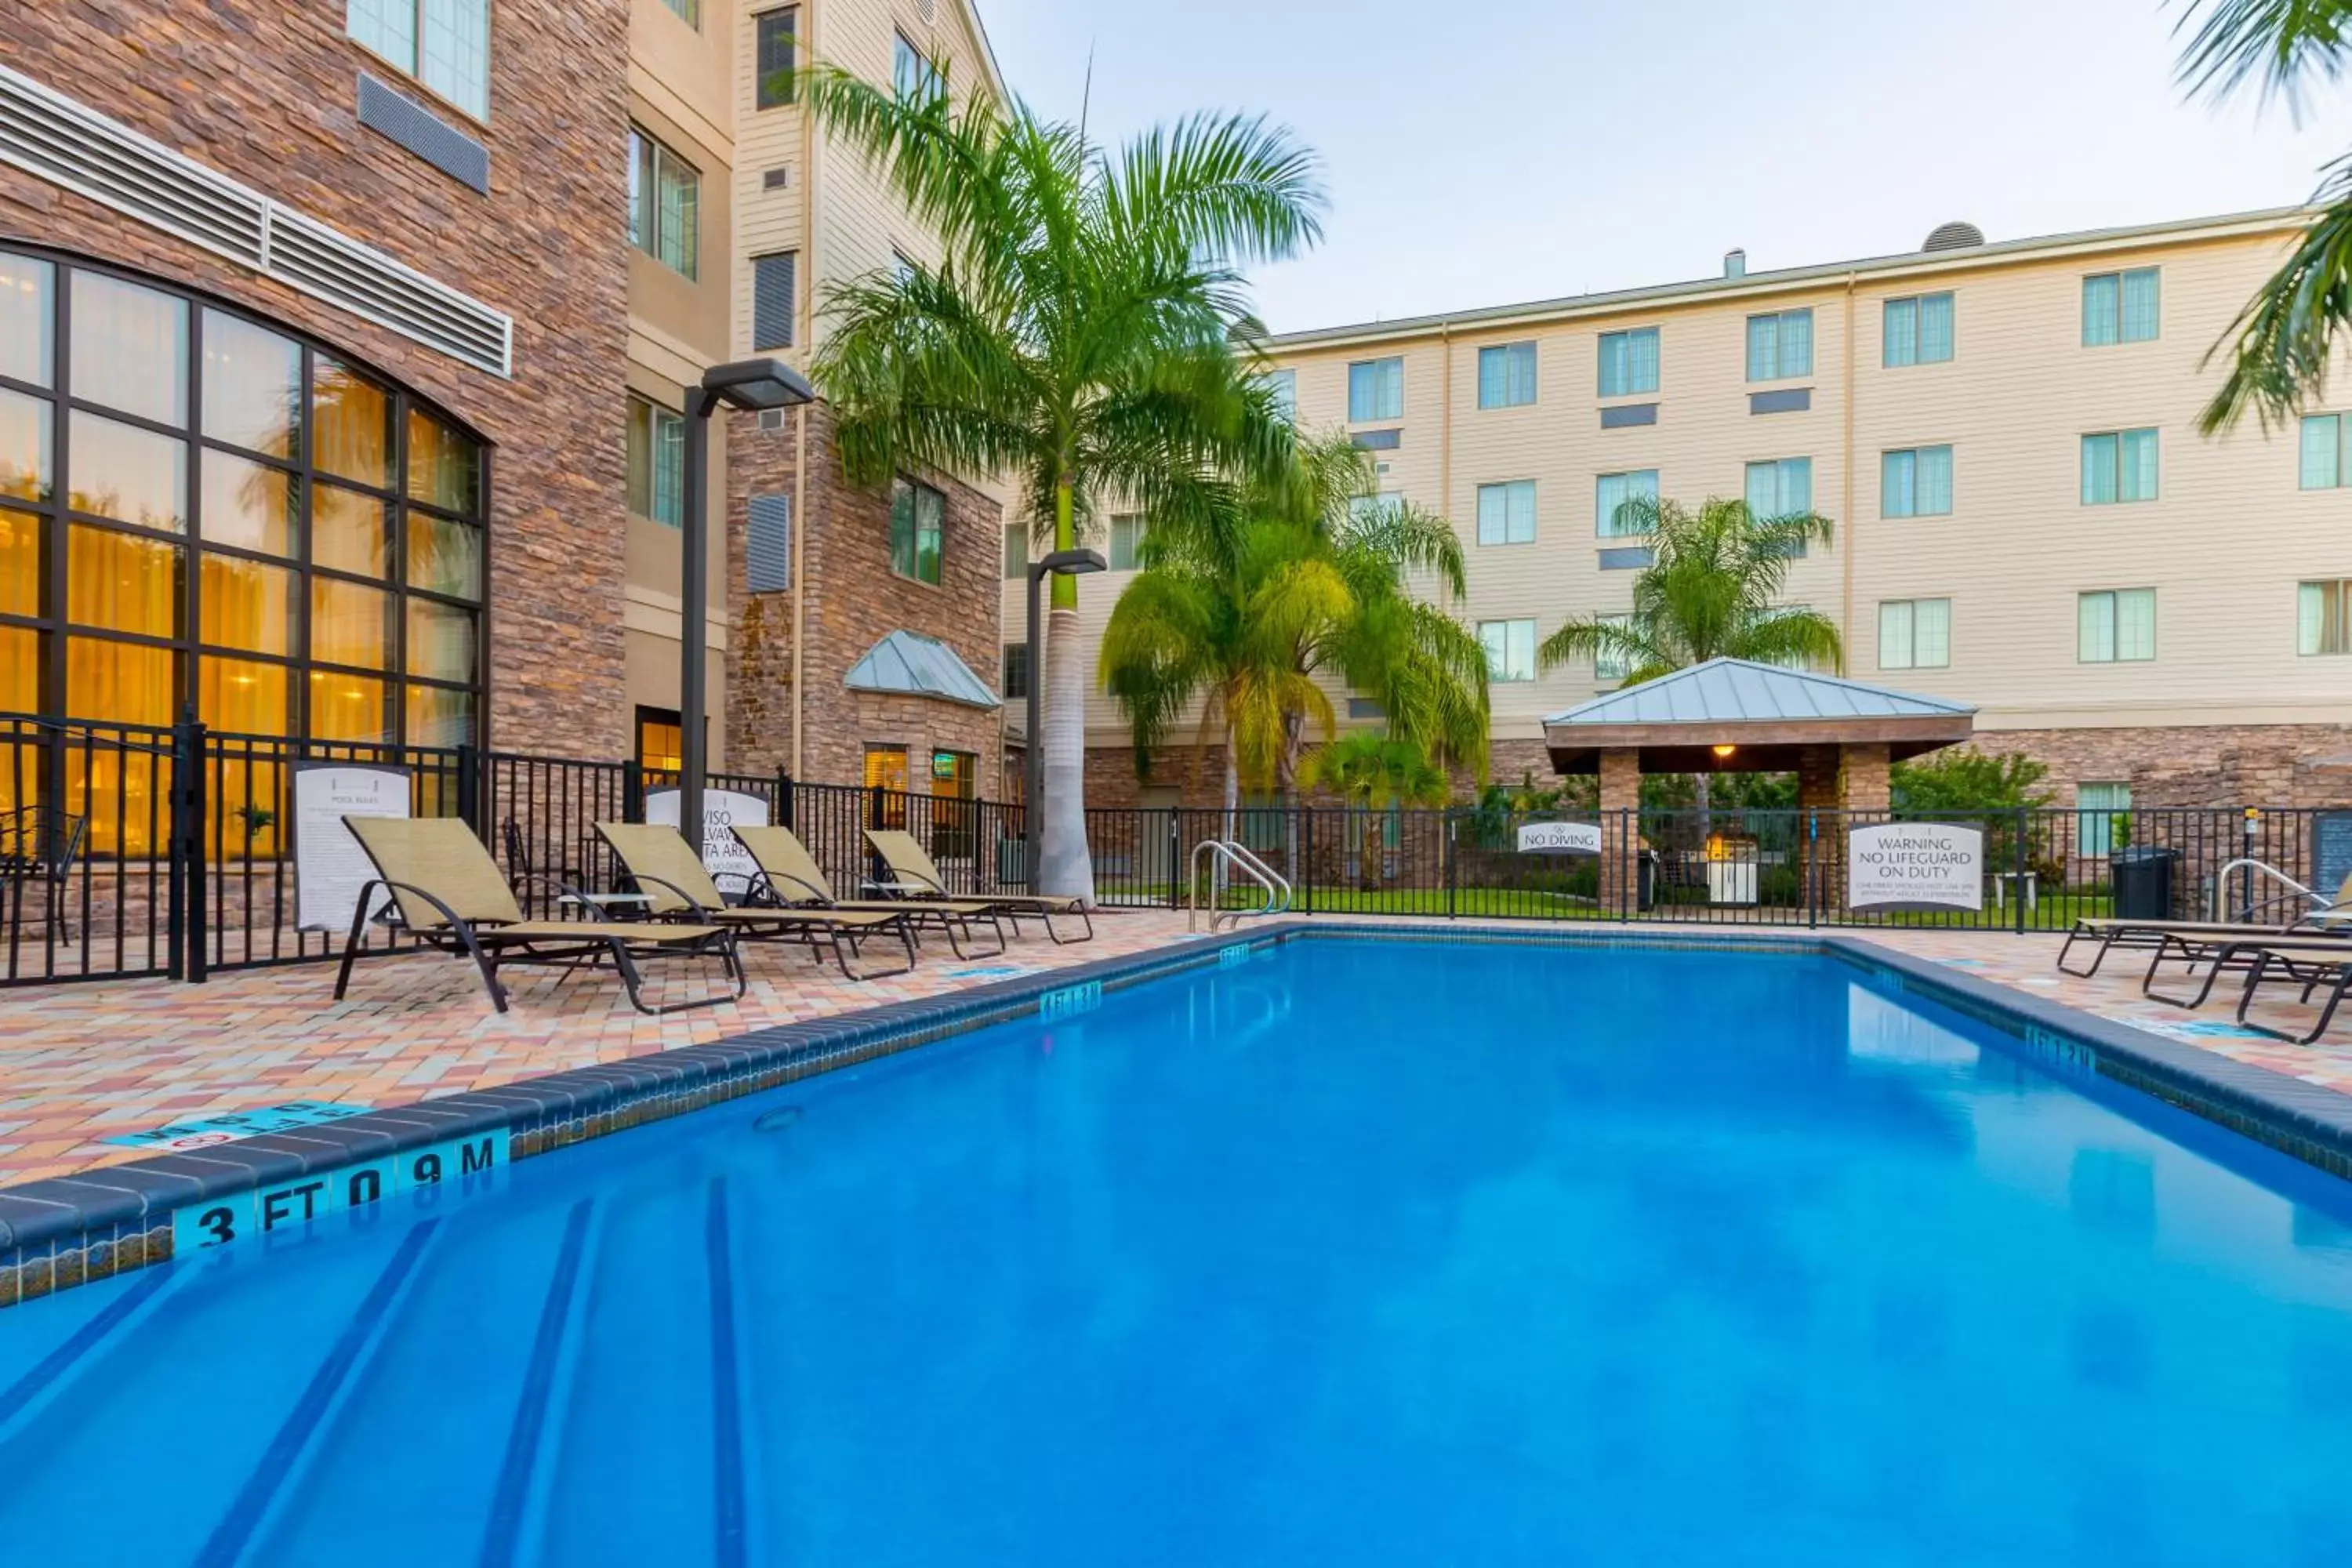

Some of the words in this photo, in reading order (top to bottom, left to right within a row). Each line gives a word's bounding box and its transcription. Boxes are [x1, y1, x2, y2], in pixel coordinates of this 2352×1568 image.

[703, 810, 731, 825] VISO
[1525, 834, 1545, 845] NO
[1550, 834, 1594, 846] DIVING
[1878, 838, 1952, 851] WARNING
[723, 844, 750, 858] ARE
[1860, 852, 1884, 864] NO
[1889, 852, 1972, 865] LIFEGUARD
[1879, 866, 1904, 878] ON
[1908, 866, 1951, 879] DUTY
[198, 1207, 235, 1247] 3
[264, 1181, 323, 1231] FT
[349, 1169, 380, 1206] 0
[413, 1154, 441, 1187] 9
[462, 1138, 493, 1175] M
